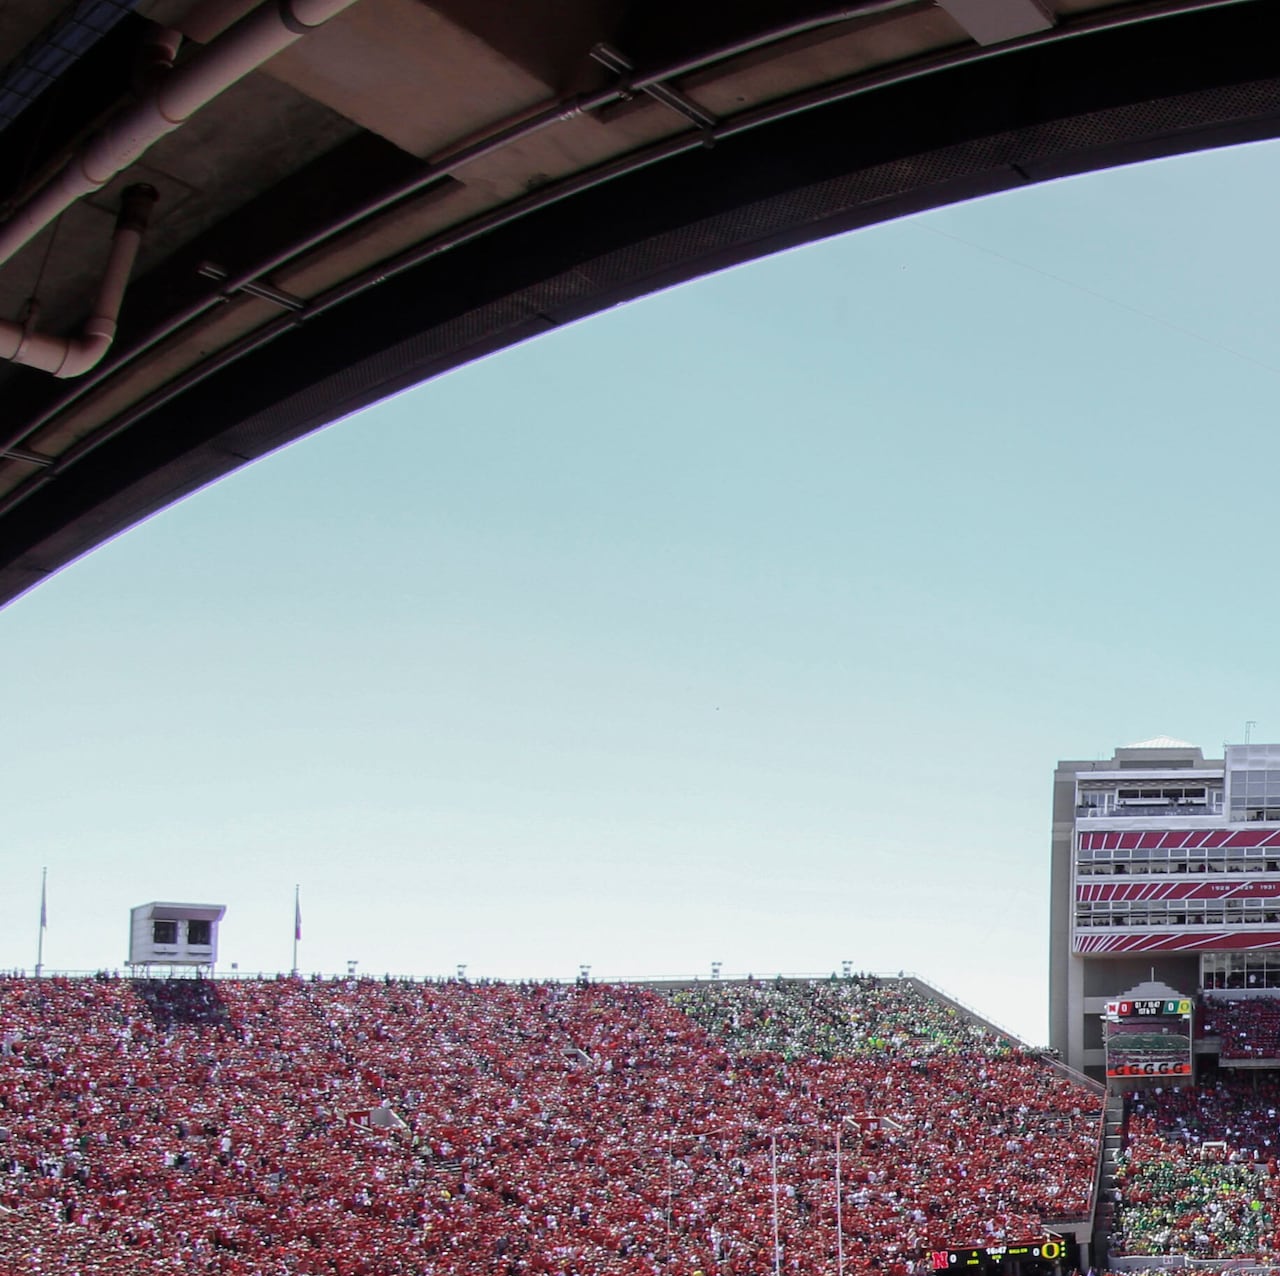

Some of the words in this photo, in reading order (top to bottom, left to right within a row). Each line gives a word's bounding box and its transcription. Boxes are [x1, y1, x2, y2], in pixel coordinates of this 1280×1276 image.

[1121, 1003, 1127, 1012] 0
[1168, 1002, 1174, 1011] 0
[1033, 1248, 1040, 1257] 0
[1041, 1242, 1060, 1259] O
[931, 1250, 949, 1269] N
[949, 1254, 957, 1264] 0
